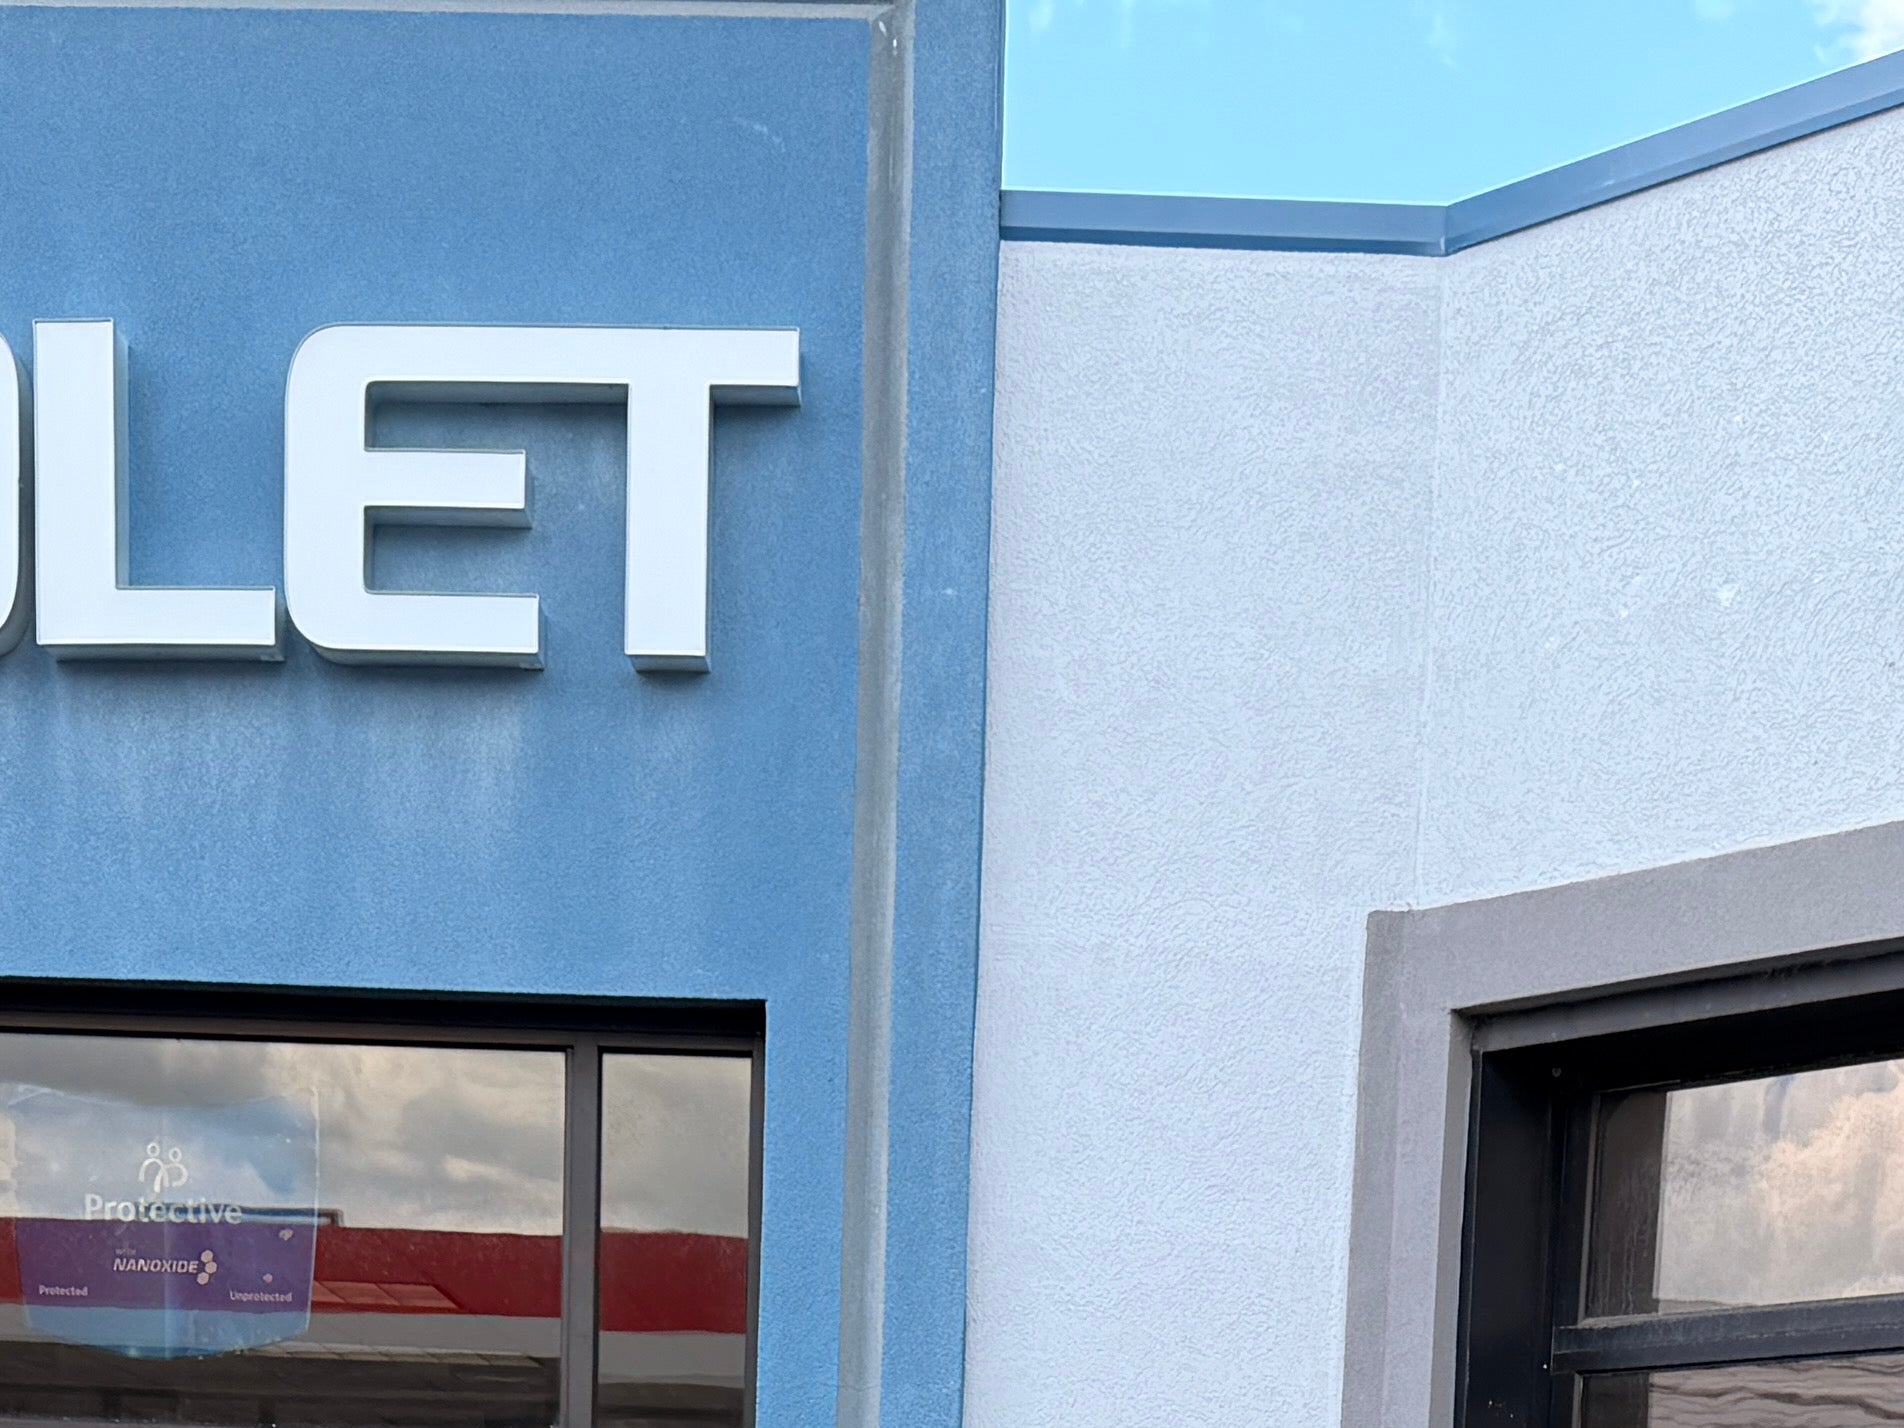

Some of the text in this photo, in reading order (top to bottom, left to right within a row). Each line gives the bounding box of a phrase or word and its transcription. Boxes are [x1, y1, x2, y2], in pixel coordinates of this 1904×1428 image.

[84, 1192, 244, 1225] Protective
[113, 1257, 200, 1274] NANOXIDE
[38, 1284, 89, 1297] Protected
[229, 1290, 293, 1303] Unprotected
